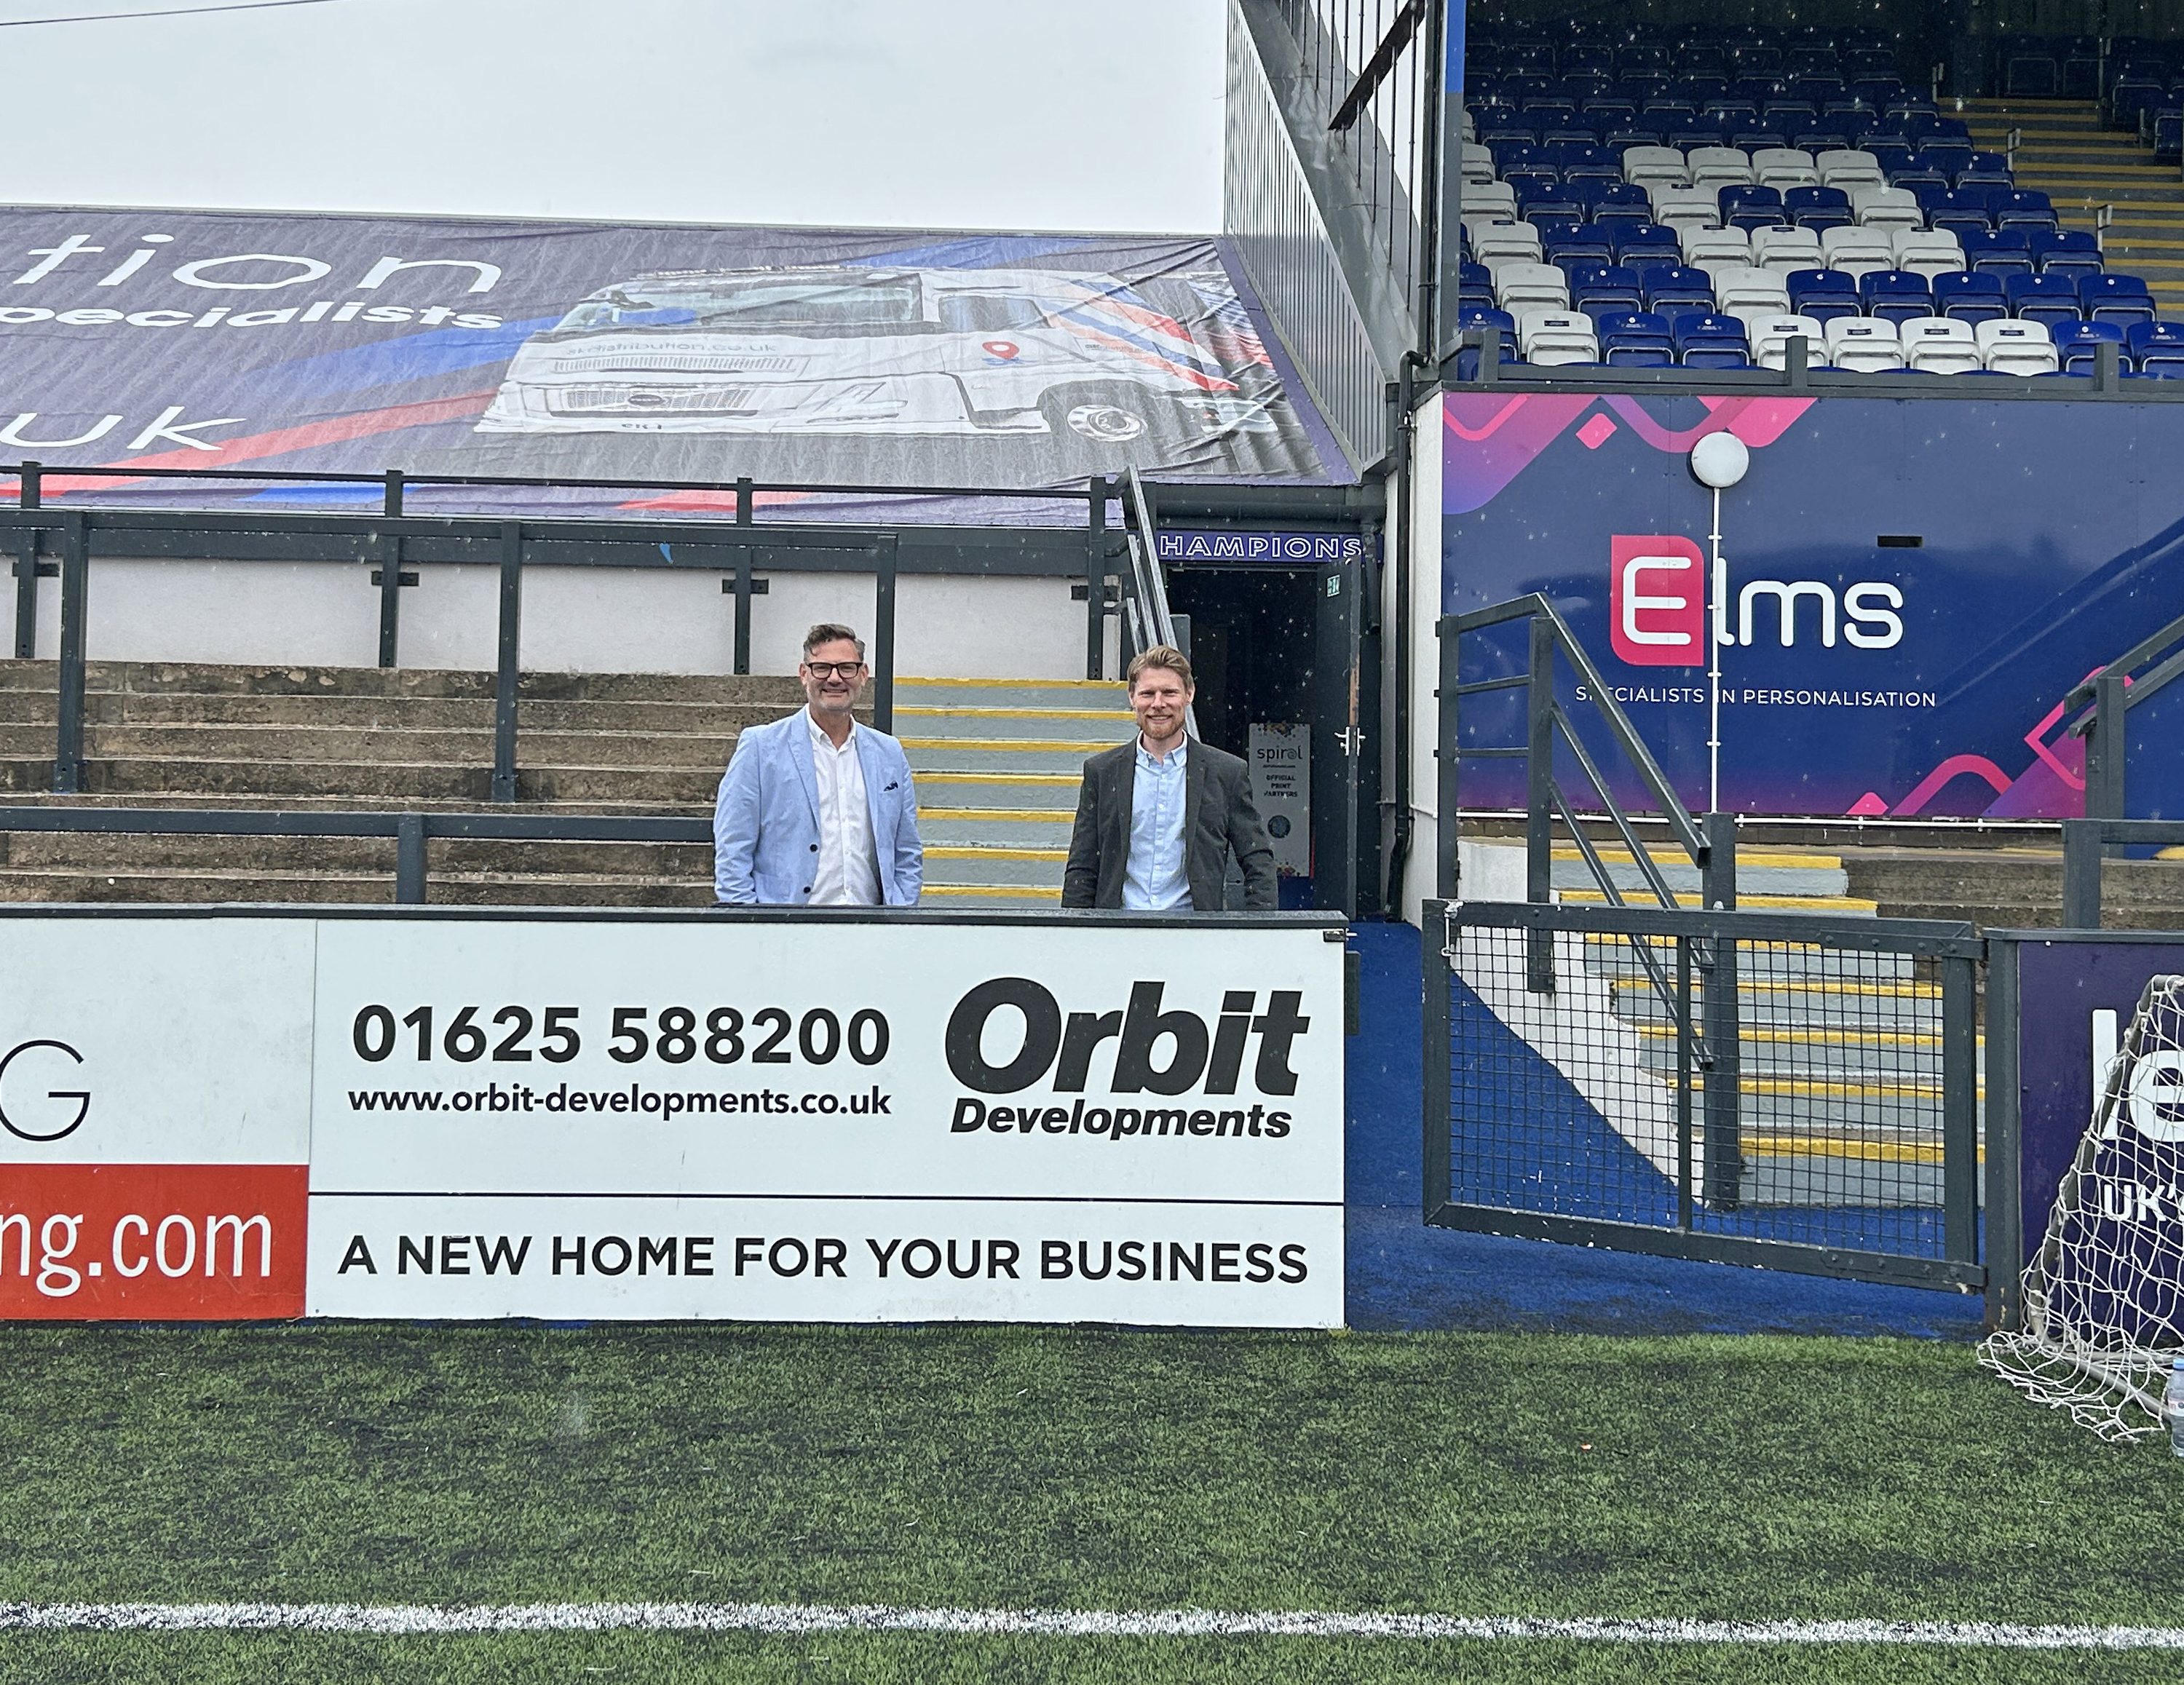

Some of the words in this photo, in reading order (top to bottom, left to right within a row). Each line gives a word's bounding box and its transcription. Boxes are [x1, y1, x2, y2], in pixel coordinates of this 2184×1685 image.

[13, 234, 502, 293] tion
[1160, 535, 1362, 558] HAMPIONS
[1623, 556, 1904, 649] Elms
[1575, 686, 1705, 703] SCIALISTS
[1744, 689, 1936, 707] PERSONALISATION
[1257, 745, 1303, 763] spiral
[1266, 774, 1296, 782] OFFICIAL
[353, 1004, 581, 1063] 01625
[607, 1007, 890, 1066] 588200
[945, 977, 1311, 1097] Orbit
[348, 1082, 892, 1122] www.orbit-developments.co.uk
[950, 1097, 1293, 1141] Developments
[2104, 1184, 2184, 1221] UK'
[0, 1213, 272, 1297] ng.com
[337, 1235, 377, 1274] A
[397, 1235, 533, 1275] NEW
[552, 1236, 714, 1276] HOME
[735, 1237, 847, 1278] FOR
[865, 1238, 1020, 1279] YOUR
[1041, 1240, 1308, 1284] BUSINESS
